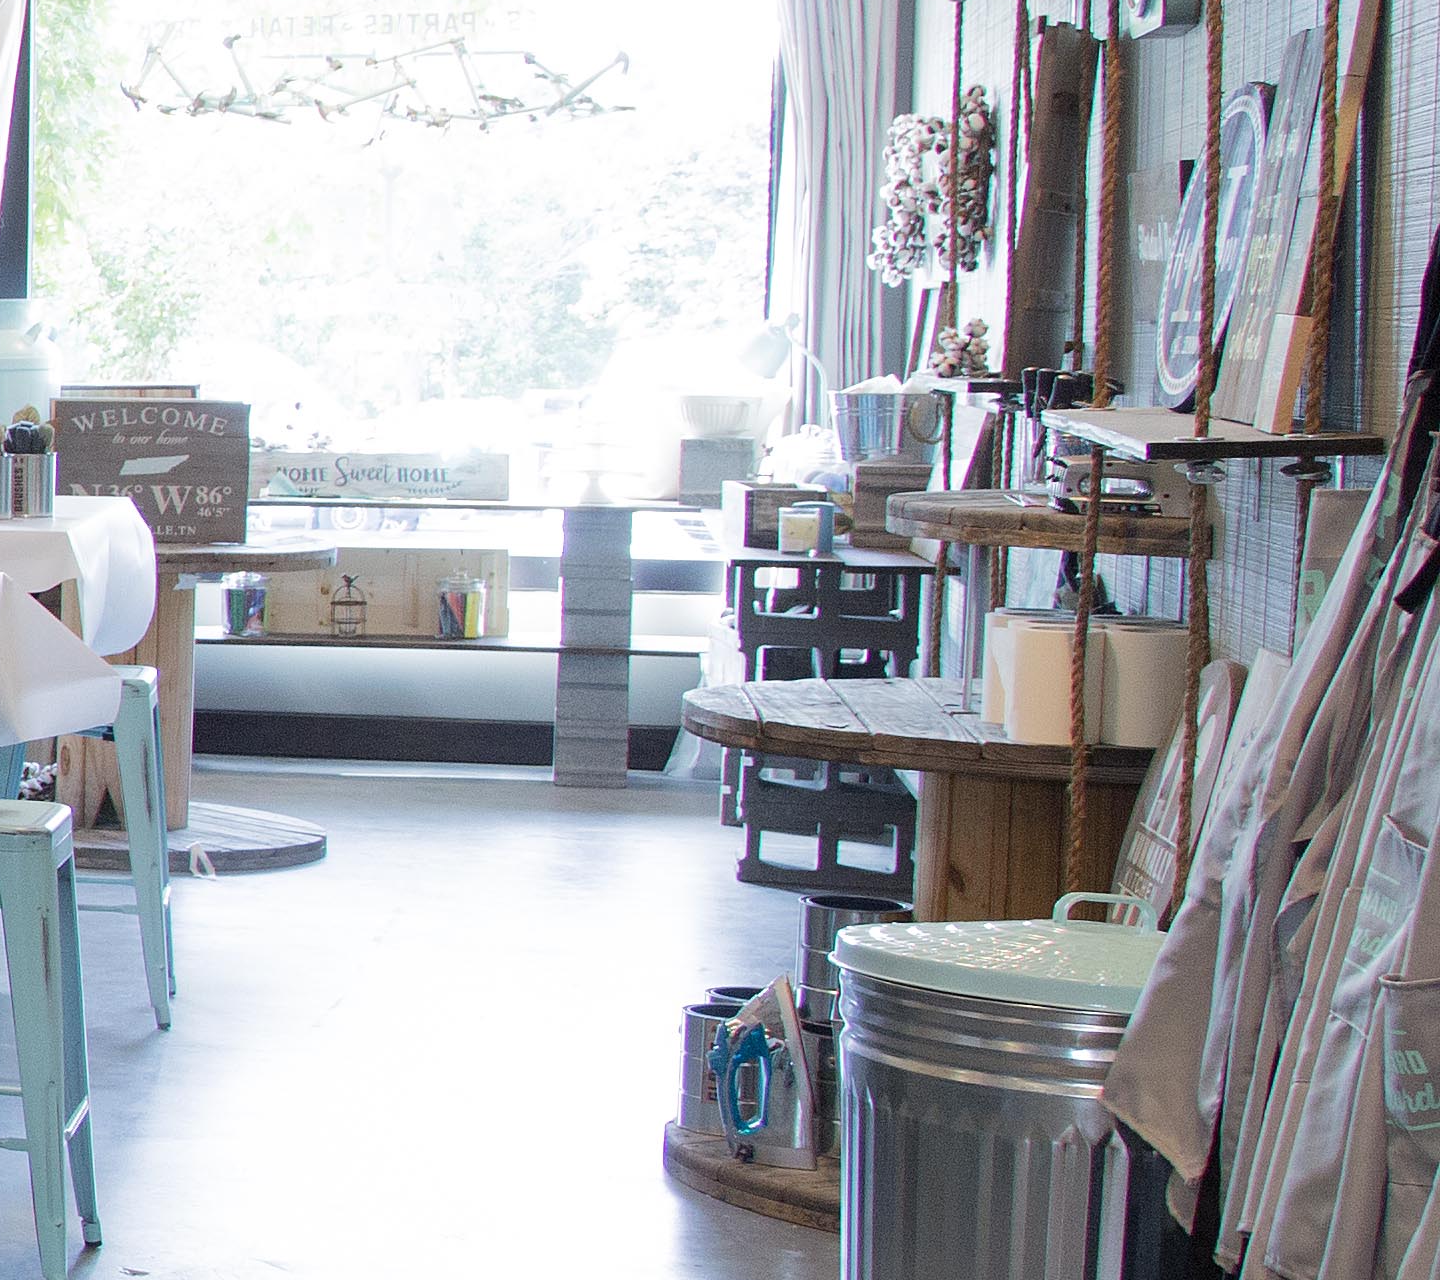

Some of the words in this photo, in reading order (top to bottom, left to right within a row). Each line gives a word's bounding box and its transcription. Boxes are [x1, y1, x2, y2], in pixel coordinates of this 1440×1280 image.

[72, 406, 228, 437] WELCOME
[112, 432, 126, 445] to
[130, 432, 152, 445] our
[156, 428, 189, 445] home
[335, 456, 391, 487] Sweet
[397, 467, 450, 483] HOME
[13, 467, 25, 514] BRUSHES
[151, 485, 192, 516] W
[195, 485, 233, 505] 86°
